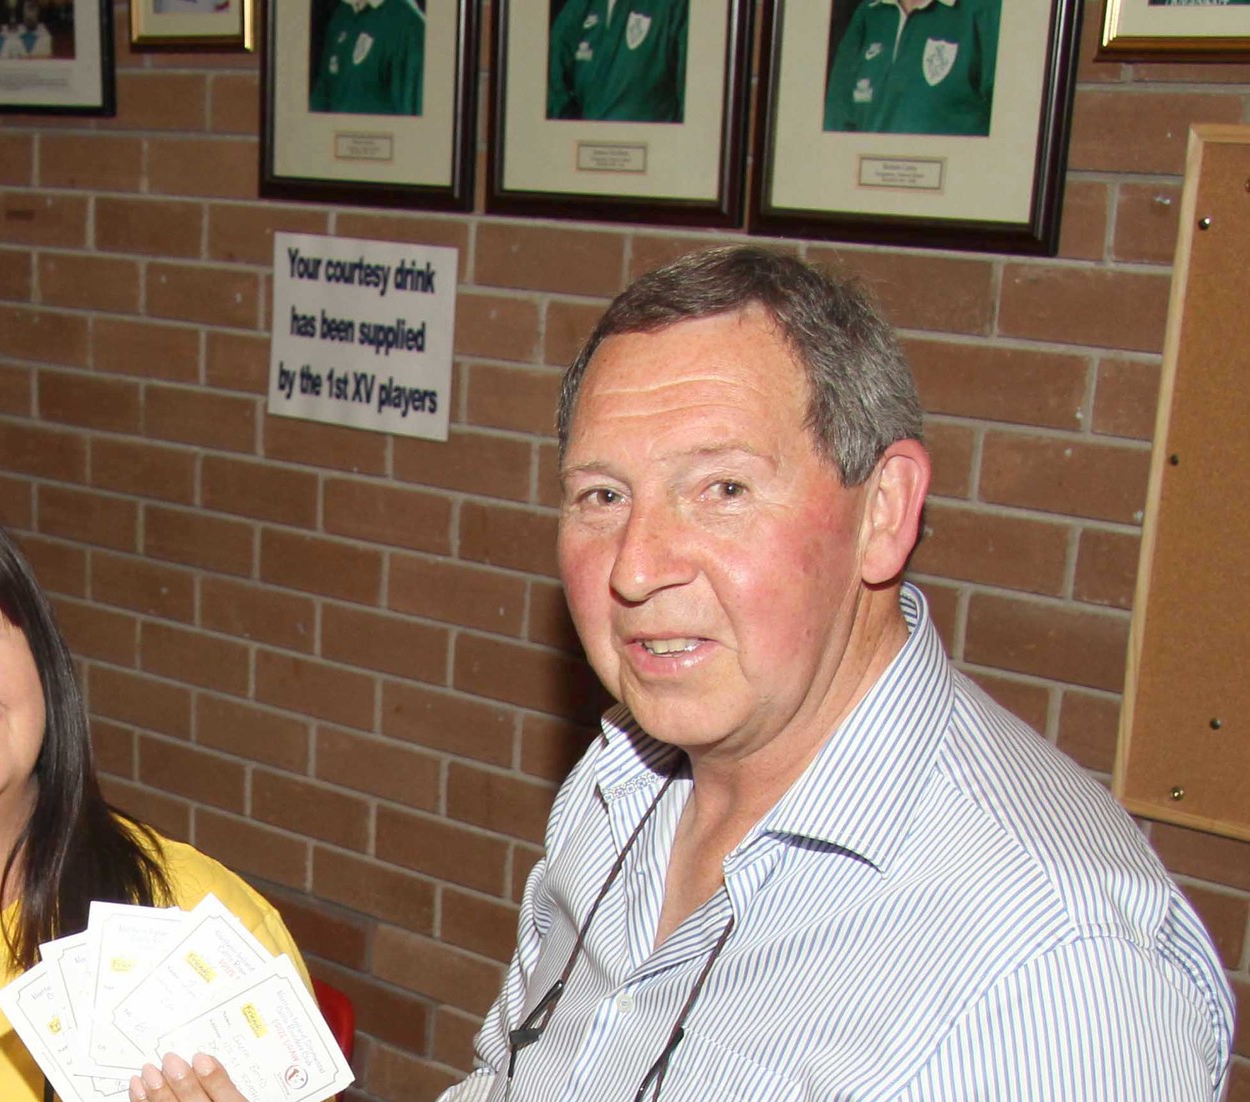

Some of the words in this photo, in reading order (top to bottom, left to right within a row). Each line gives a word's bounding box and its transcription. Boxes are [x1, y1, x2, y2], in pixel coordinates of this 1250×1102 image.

[287, 247, 322, 280] Your
[325, 255, 391, 297] courtesy
[394, 258, 436, 293] drink
[290, 305, 316, 338] has
[320, 309, 354, 342] been
[358, 318, 426, 356] supplied
[277, 361, 296, 400] by
[300, 365, 322, 396] the
[327, 367, 348, 400] 1st
[352, 371, 375, 404] XV
[378, 375, 438, 418] players
